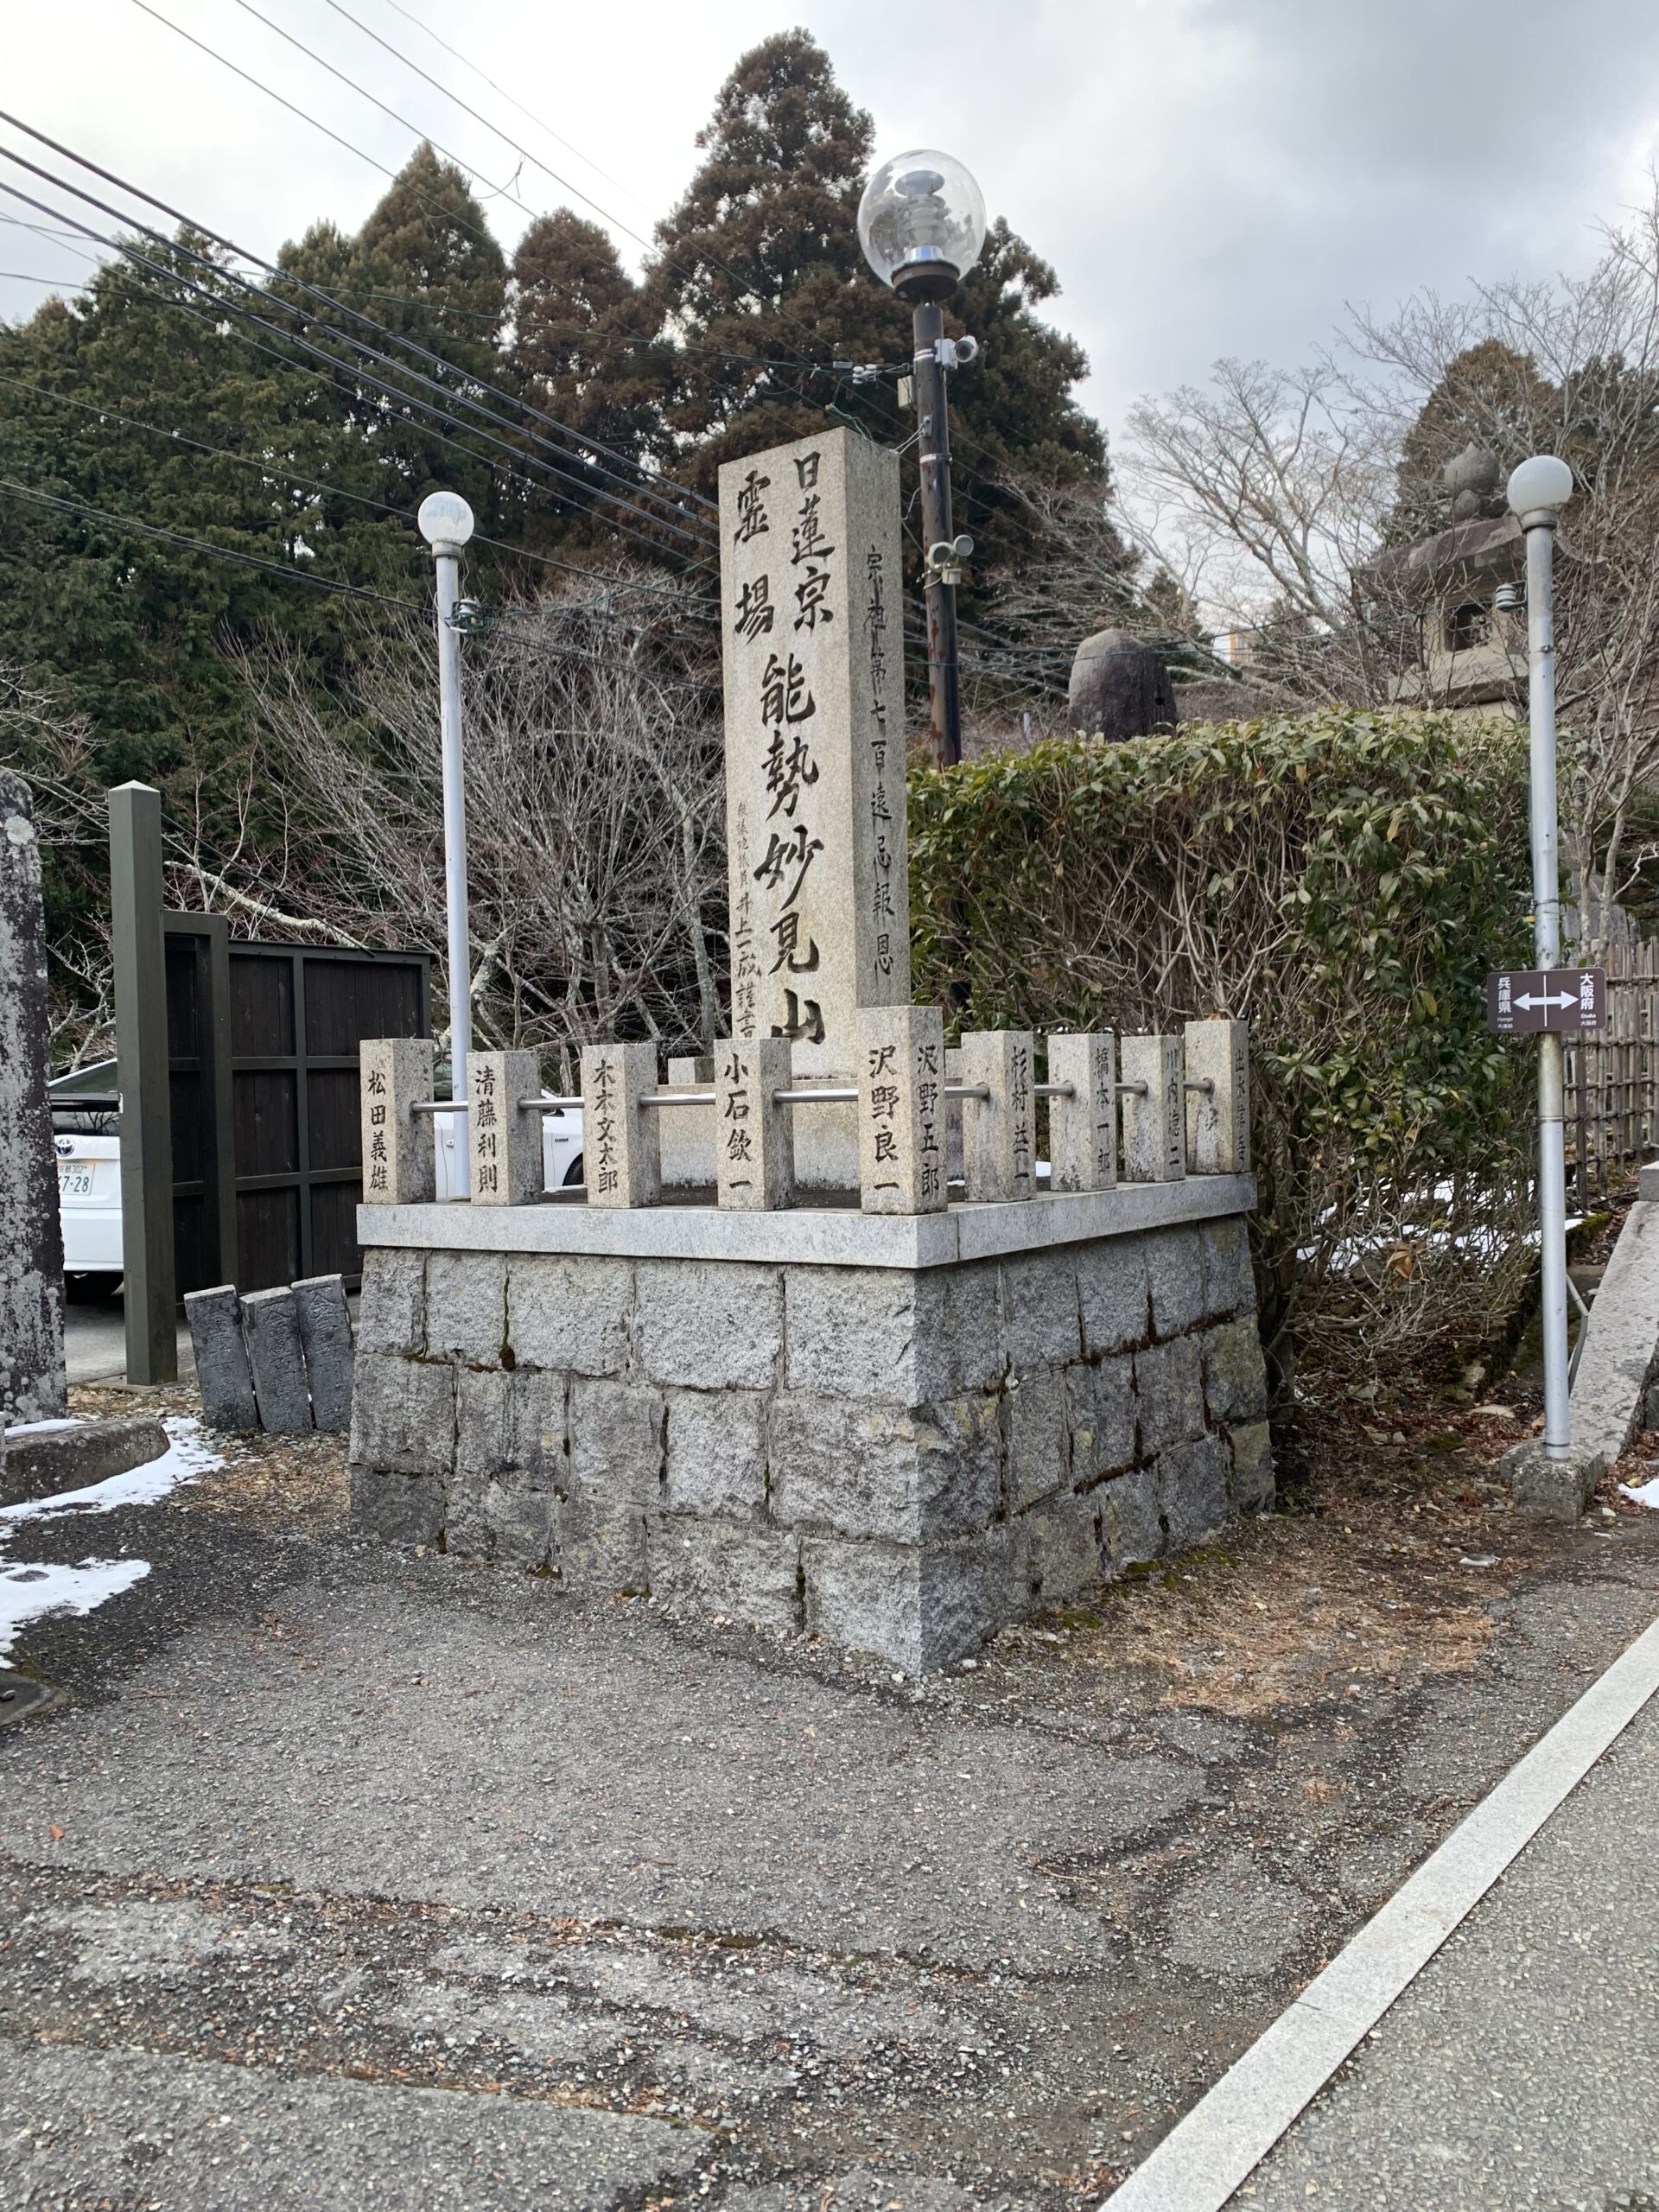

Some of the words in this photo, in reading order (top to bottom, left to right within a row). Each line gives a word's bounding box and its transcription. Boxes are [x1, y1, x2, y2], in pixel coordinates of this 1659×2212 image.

[791, 451, 835, 631] 日蓮宗
[753, 653, 827, 1045] 能勢妙見山
[1497, 976, 1511, 1014] 兵庫県
[1580, 973, 1594, 1010] 大阪府
[368, 1070, 388, 1191] 松田義雄
[474, 1065, 498, 1193] 清藤利則
[594, 1058, 619, 1193] 木本文太郎
[724, 1052, 753, 1189] 小石欽一
[868, 1045, 900, 1191] 沢野良一
[918, 1044, 939, 1196] 沢野五郎
